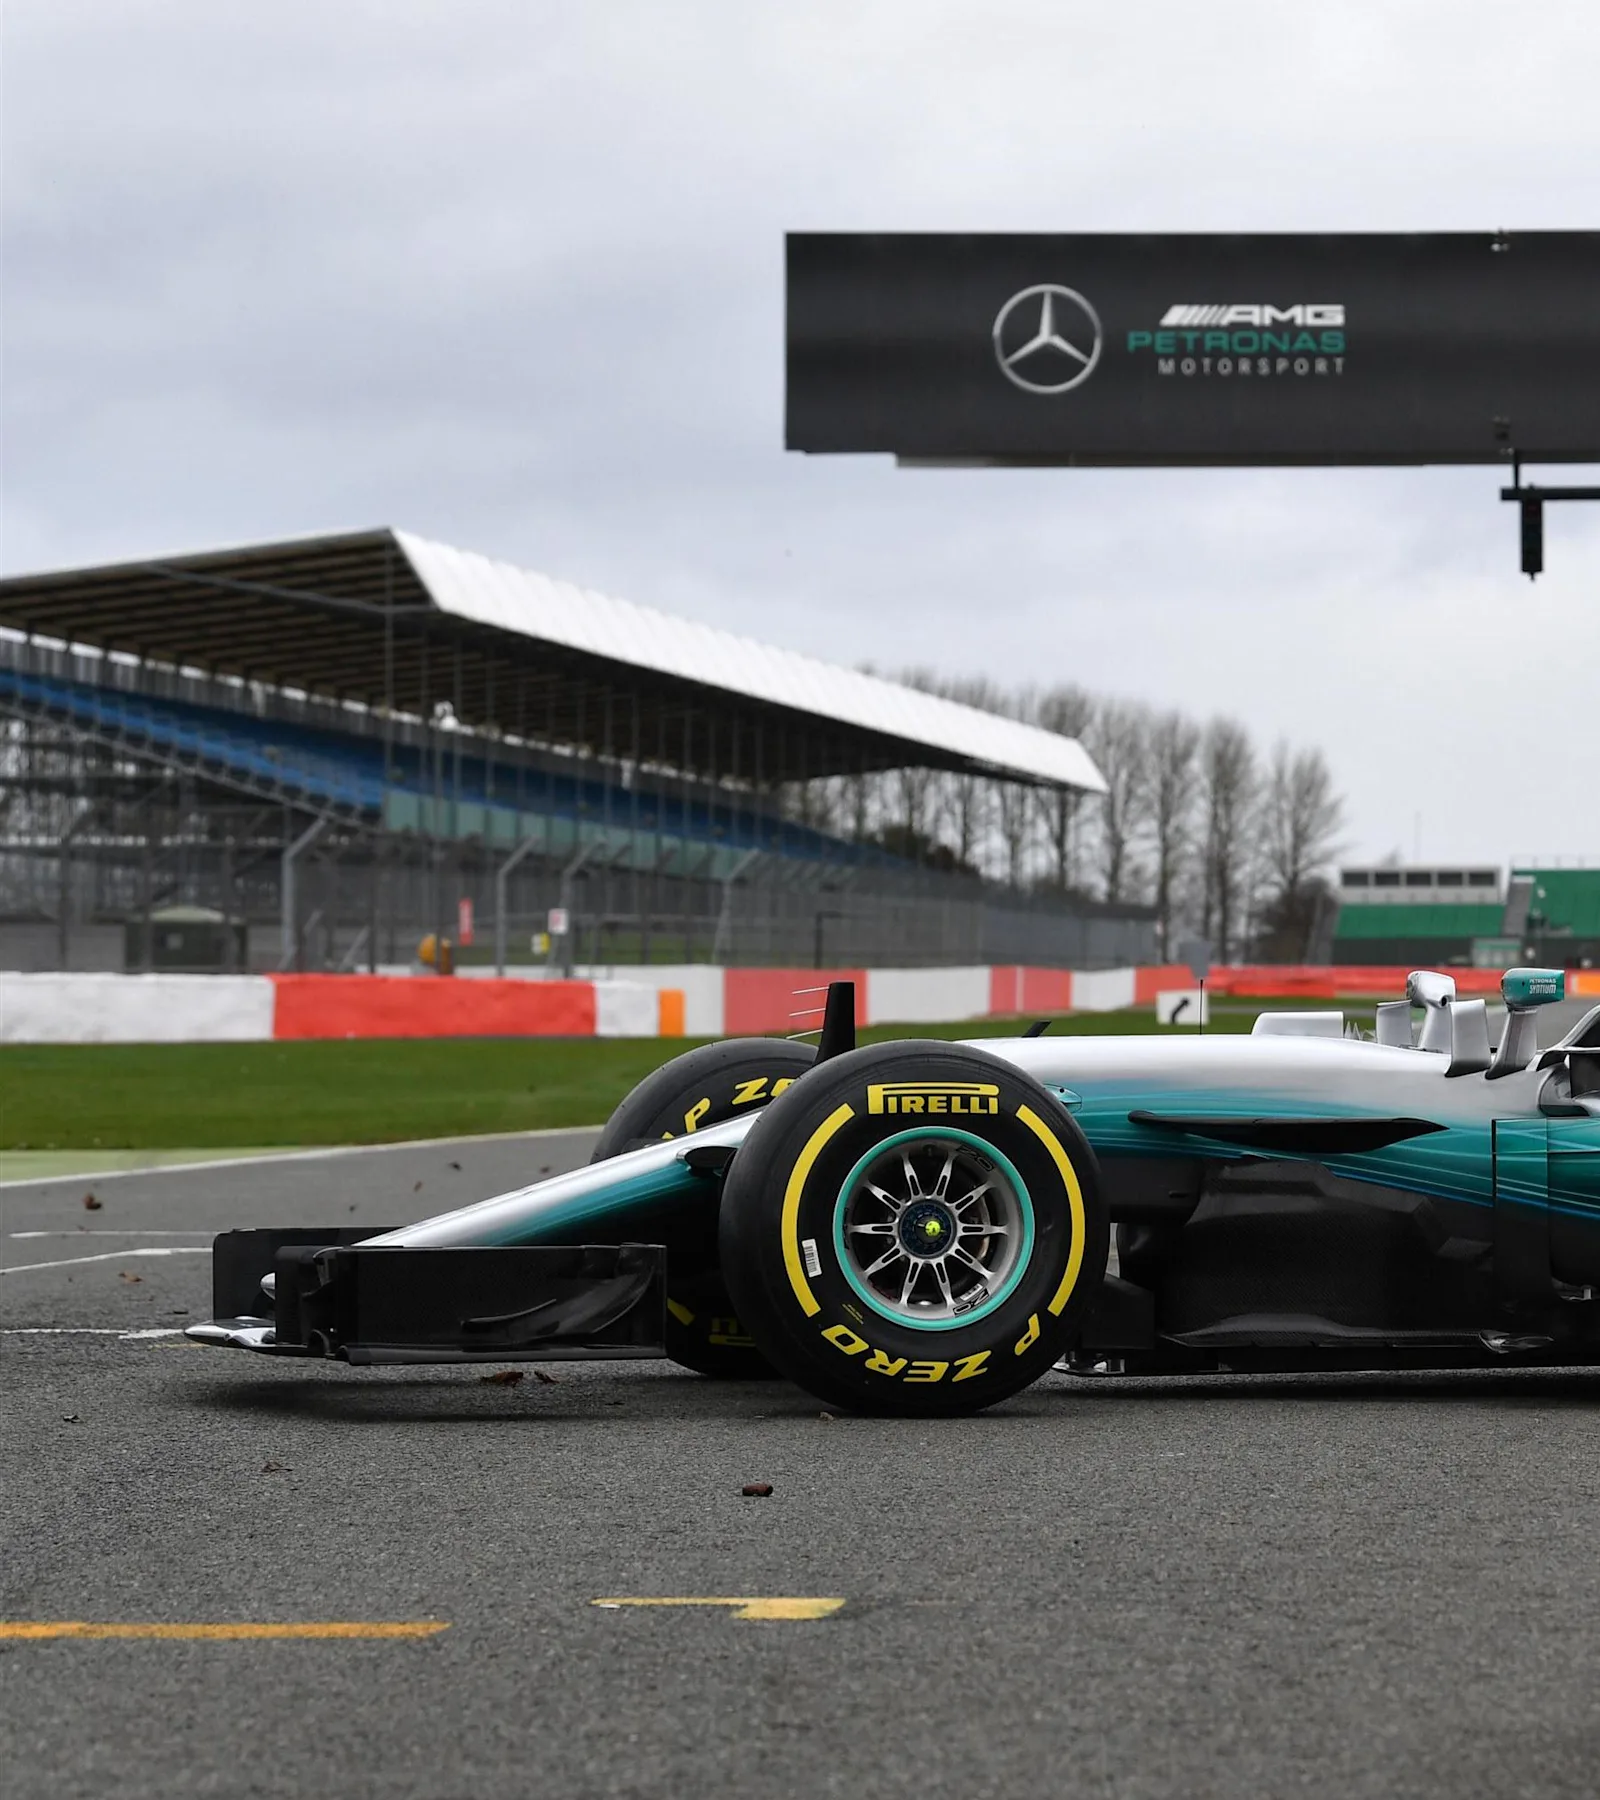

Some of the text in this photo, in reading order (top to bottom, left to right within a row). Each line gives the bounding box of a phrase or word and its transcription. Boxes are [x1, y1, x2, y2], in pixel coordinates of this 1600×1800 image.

[1220, 304, 1345, 326] AMG
[1127, 330, 1346, 353] PETRONAS
[1158, 357, 1345, 375] MOTORSPORT
[868, 1082, 999, 1115] PIRELLI
[820, 1313, 1041, 1383] P ZERO
